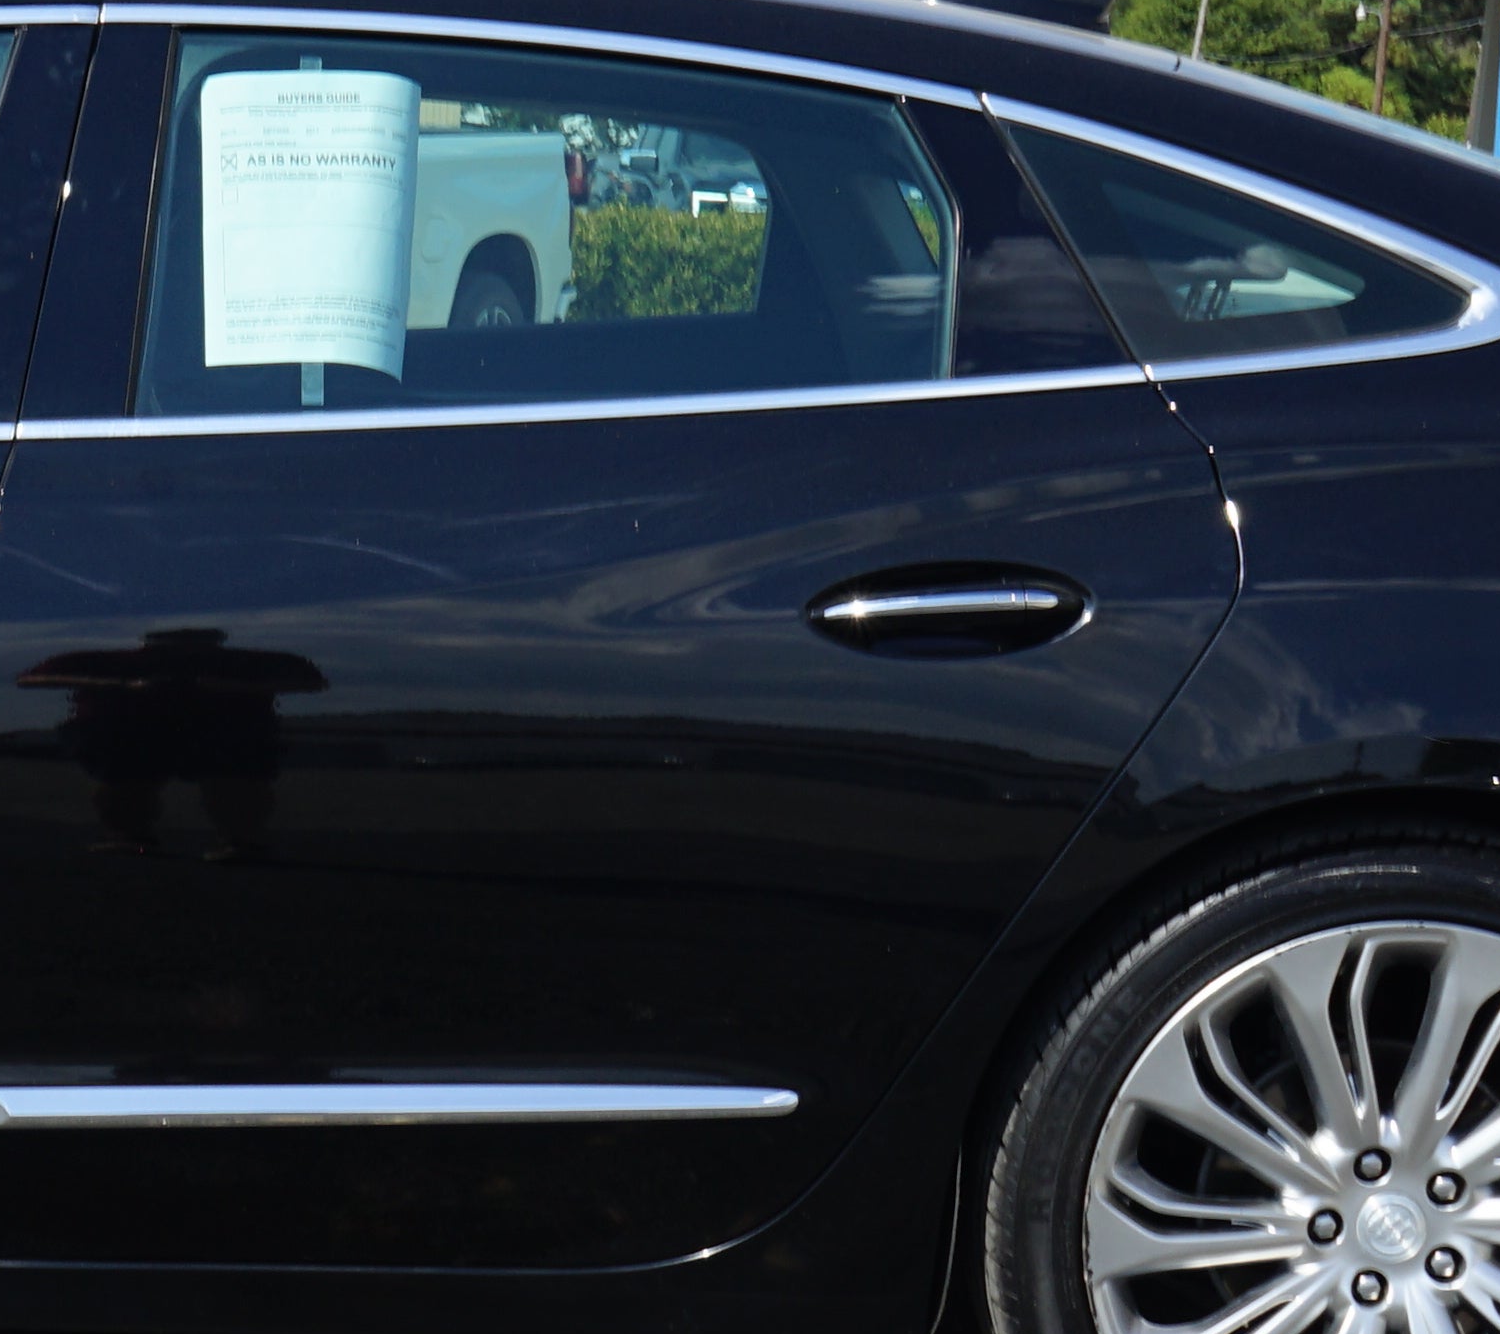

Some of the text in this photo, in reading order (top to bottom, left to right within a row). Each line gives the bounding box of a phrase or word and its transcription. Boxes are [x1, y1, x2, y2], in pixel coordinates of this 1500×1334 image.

[327, 92, 361, 104] GUIDE
[247, 152, 396, 171] AS IS NO WARRANTY
